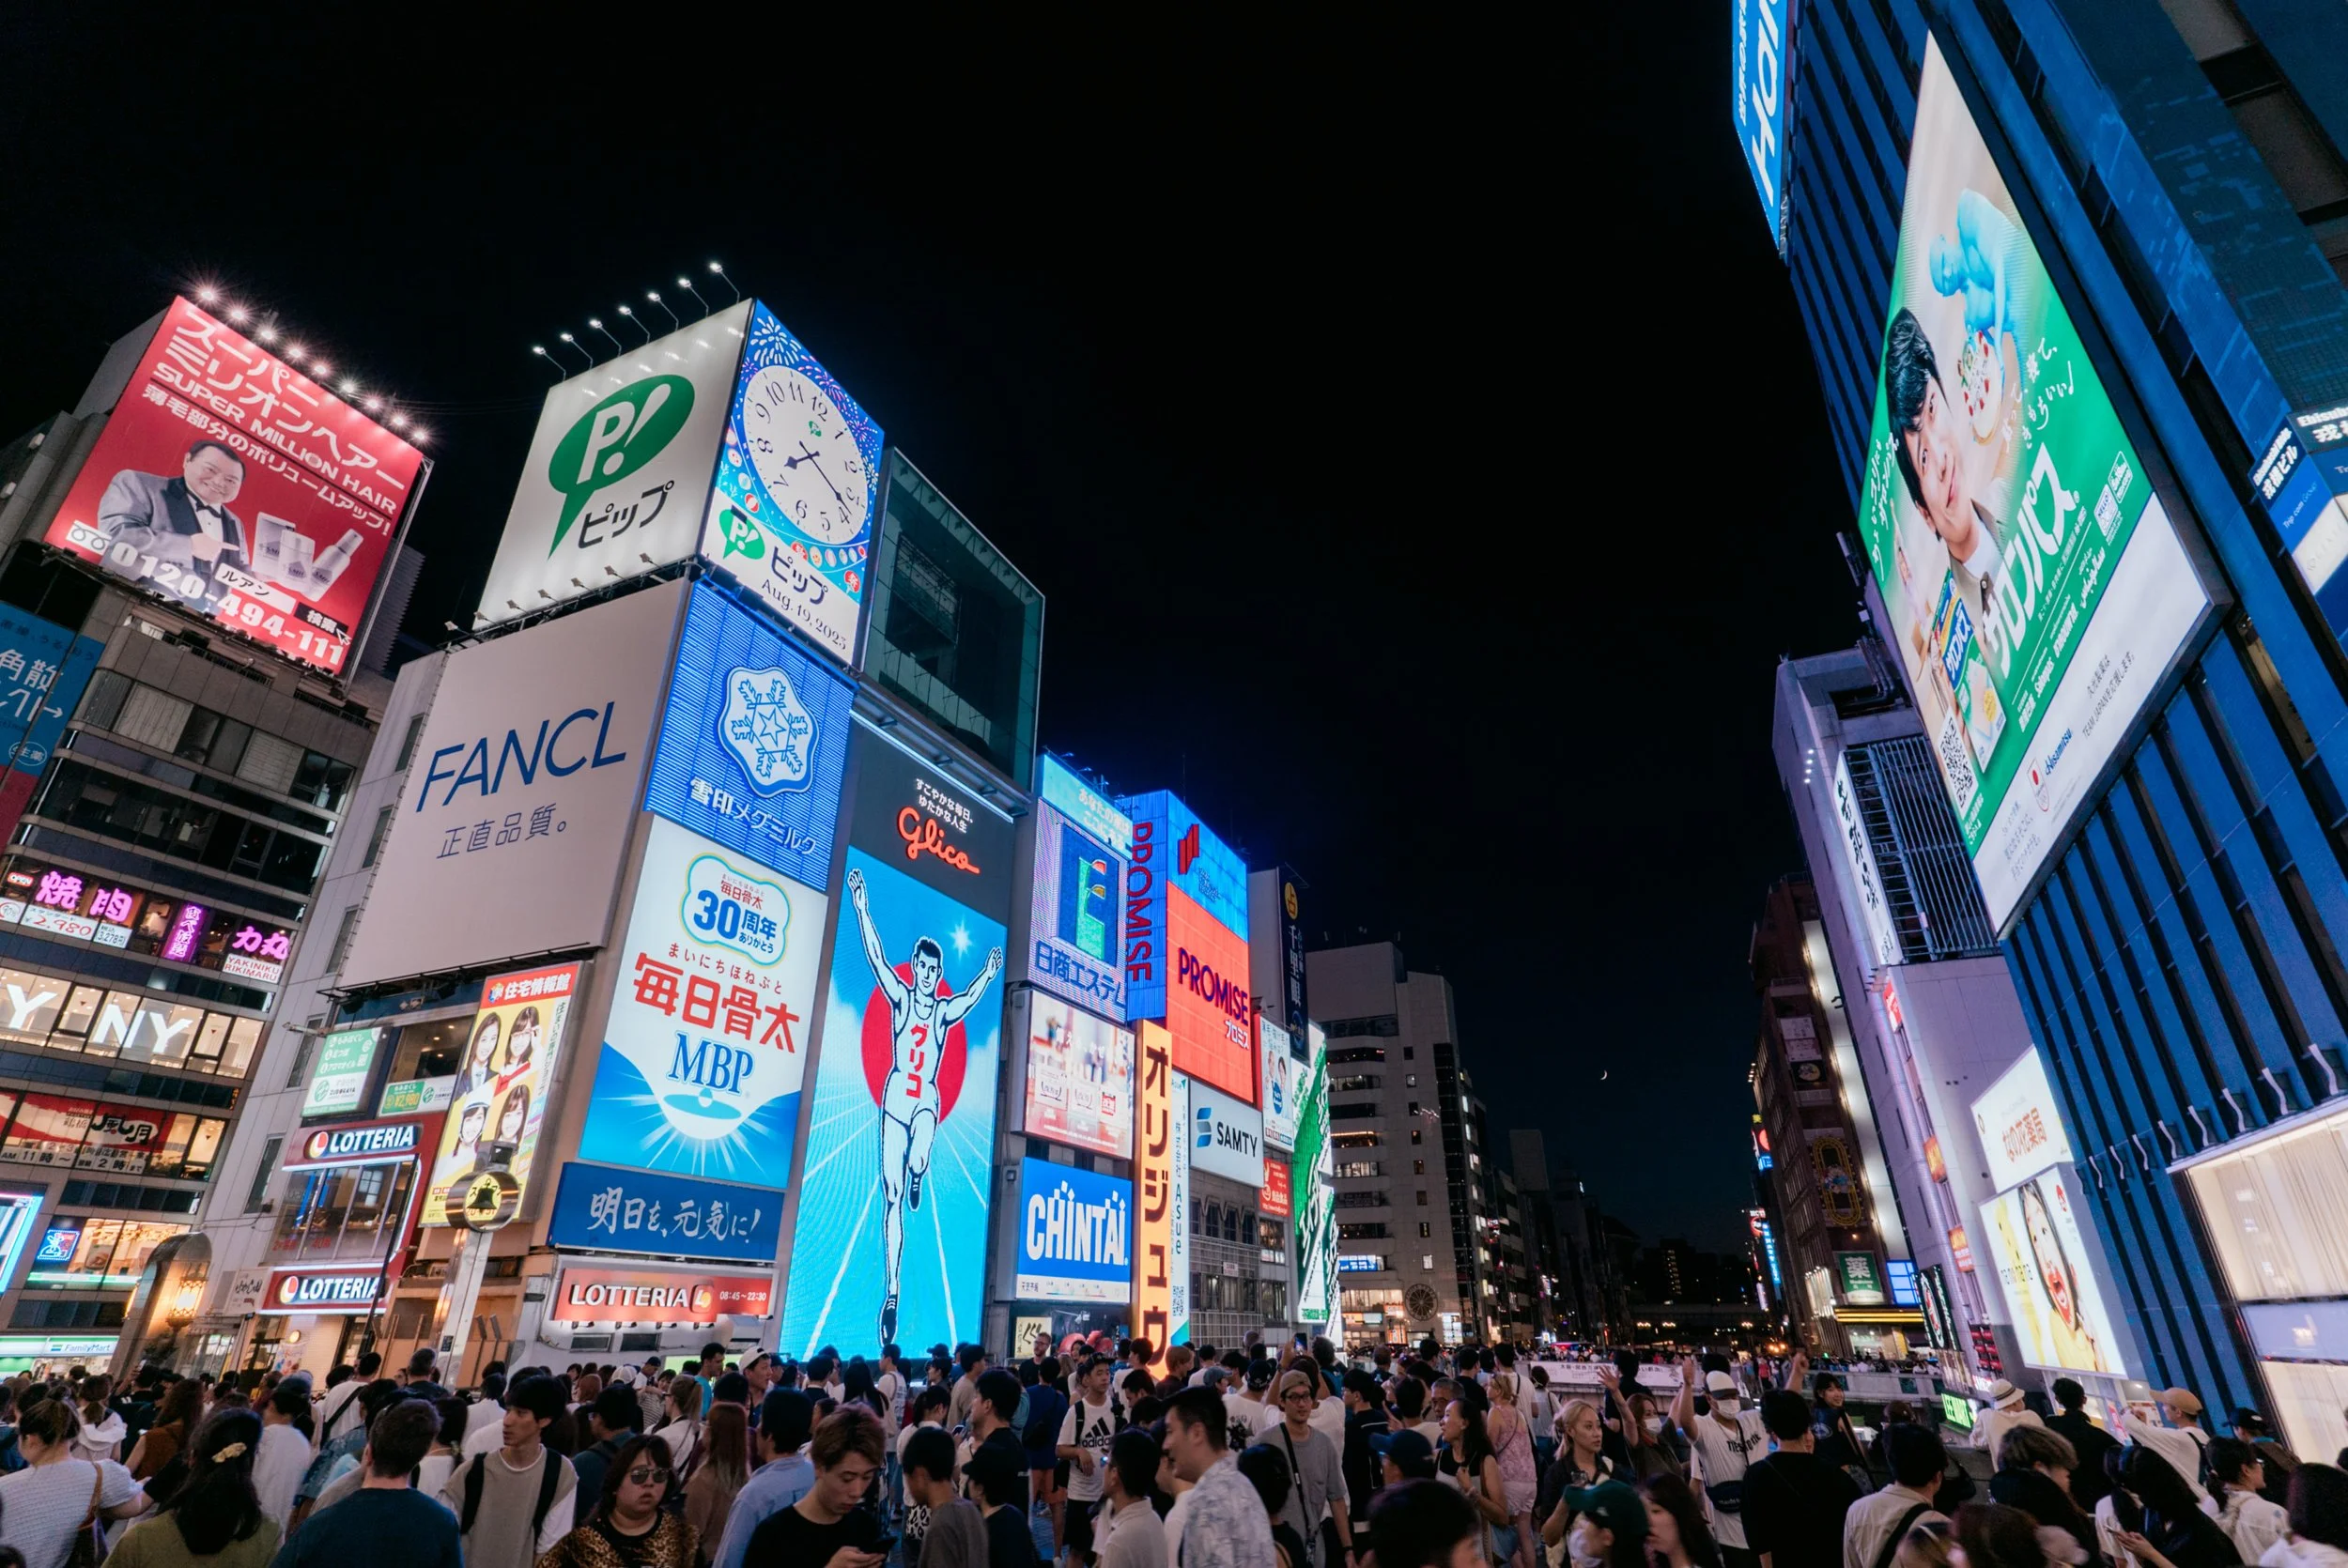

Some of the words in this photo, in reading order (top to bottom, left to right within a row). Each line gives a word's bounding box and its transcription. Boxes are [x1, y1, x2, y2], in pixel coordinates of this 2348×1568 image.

[178, 311, 320, 407] スーパー
[153, 361, 246, 428] SUPER
[251, 419, 339, 481] MILLION
[342, 472, 398, 516] HAIR
[165, 335, 405, 491] ミリオンヘアー
[578, 480, 675, 550] ピップ
[222, 570, 270, 597] ルアン
[771, 546, 829, 606] ピップ
[1983, 442, 2077, 680] サロンパス
[110, 542, 345, 666] 0120-494-111
[305, 609, 338, 634] 検索
[762, 579, 795, 612] Aug.
[816, 621, 847, 652] 2023
[1944, 610, 1973, 680] サロンパス
[416, 701, 626, 813] FANCL
[2045, 728, 2073, 776] Hisamitsu
[688, 774, 817, 857] 雪印メグミルク
[916, 777, 974, 824] すこやかな毎日、
[919, 794, 968, 834] ゆたかな人生
[436, 803, 567, 860] 正直品質。
[898, 806, 981, 875] Glico
[36, 870, 132, 923] 焼肉
[693, 889, 778, 940] 30周年
[720, 879, 765, 911] 毎日骨太
[1126, 821, 1153, 983] PROMISE
[227, 956, 281, 975] YAKINIKU
[668, 942, 782, 995] まいにちほねぶと
[738, 931, 775, 954] ありがとう
[224, 962, 278, 982] RIKIMARU
[504, 973, 572, 1001] 住宅情報館
[1179, 947, 1249, 1026] PROMISE
[633, 951, 800, 1053] 毎日骨太
[905, 1022, 930, 1100] グリコ
[1225, 1019, 1250, 1050] プロミス
[668, 1030, 754, 1094] MBP
[330, 1126, 414, 1153] LOTTERIA
[1217, 1121, 1258, 1159] SAMTY
[300, 1277, 380, 1300] LOTTERIA
[1845, 1256, 1871, 1278] 薬
[570, 1284, 689, 1308] LOTTERIA
[64, 1343, 111, 1354] FamilyMart
[1081, 1435, 1114, 1448] adida
